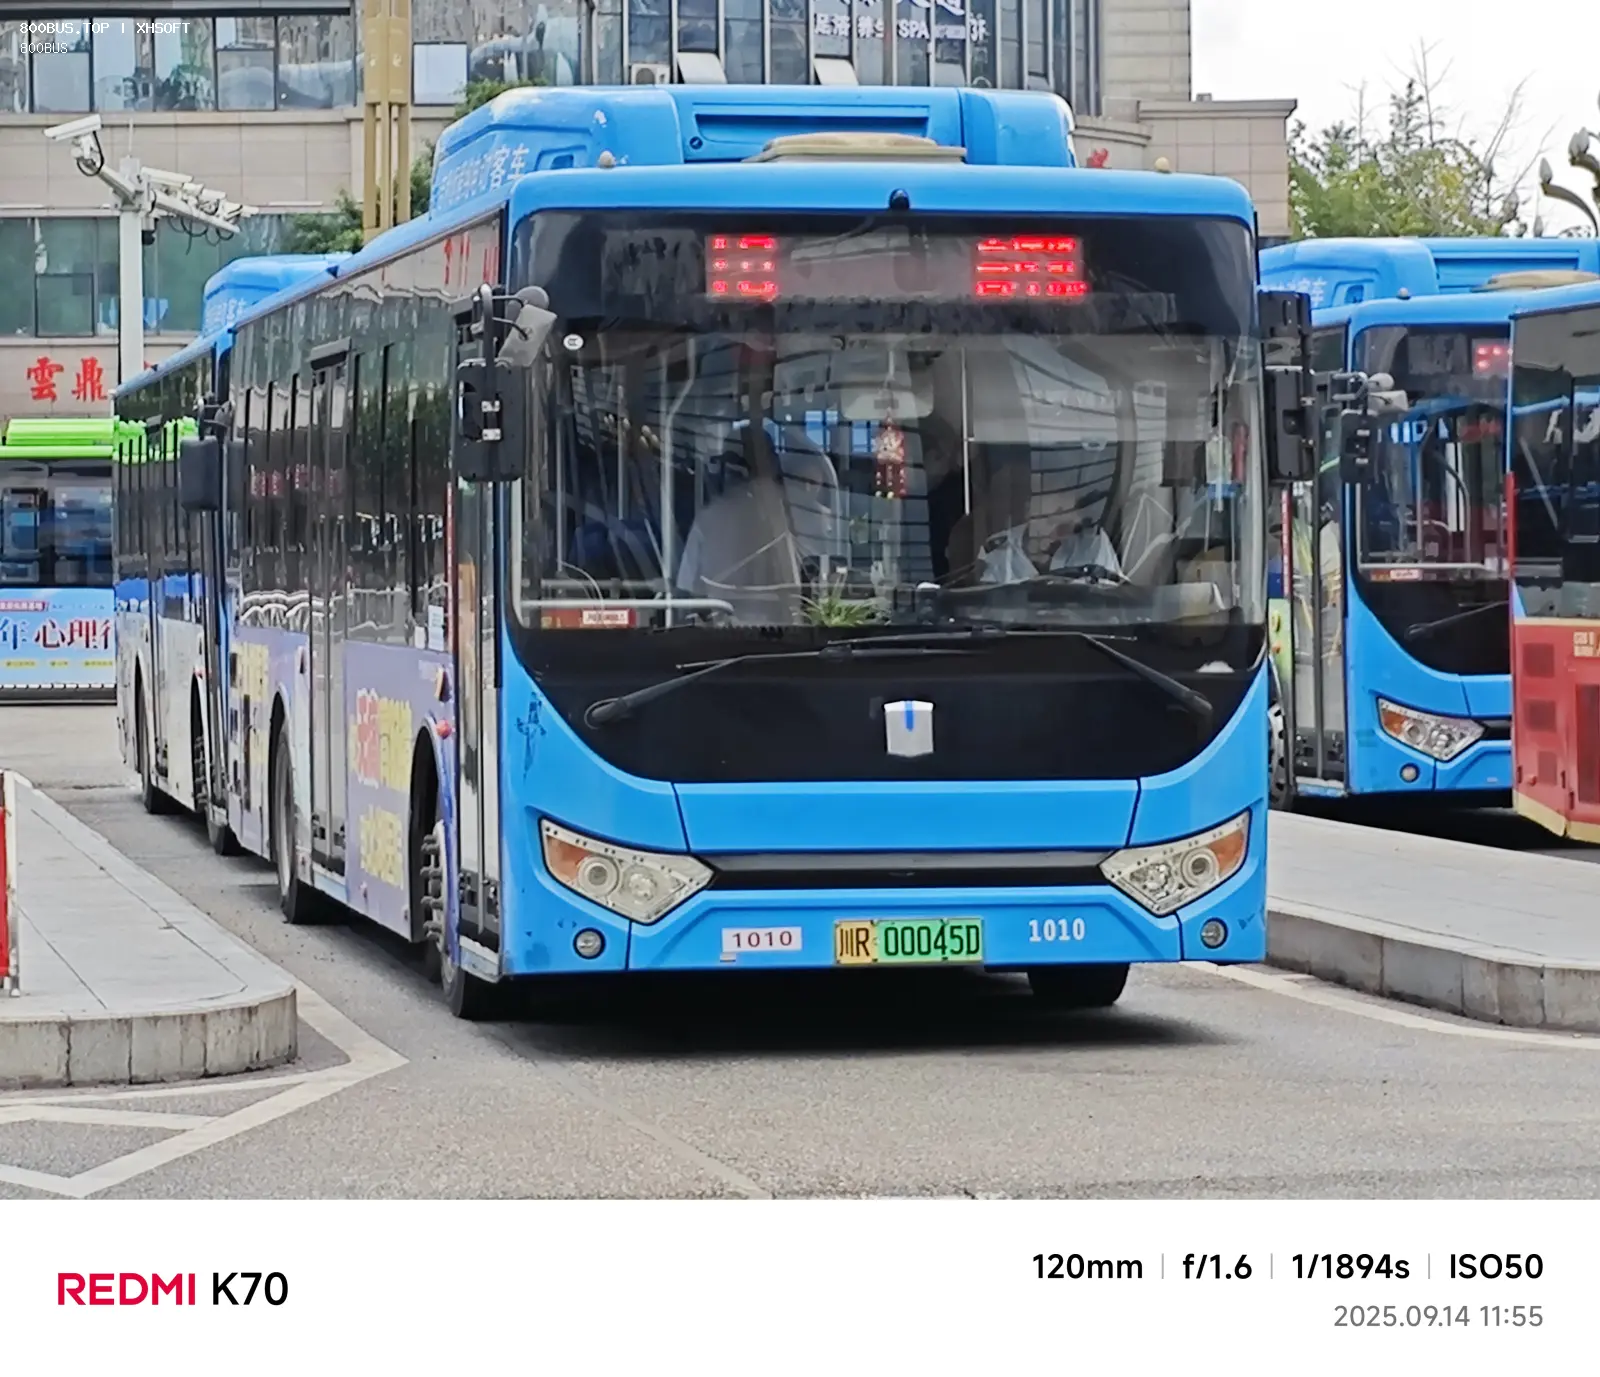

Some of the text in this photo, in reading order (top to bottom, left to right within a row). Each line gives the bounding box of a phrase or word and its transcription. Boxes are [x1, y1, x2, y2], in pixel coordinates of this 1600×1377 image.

[898, 20, 930, 39] SPA
[27, 356, 108, 402] 雲鼎
[732, 930, 792, 949] 1010
[839, 924, 980, 957] 川R 00045D
[1028, 918, 1086, 942] 1010
